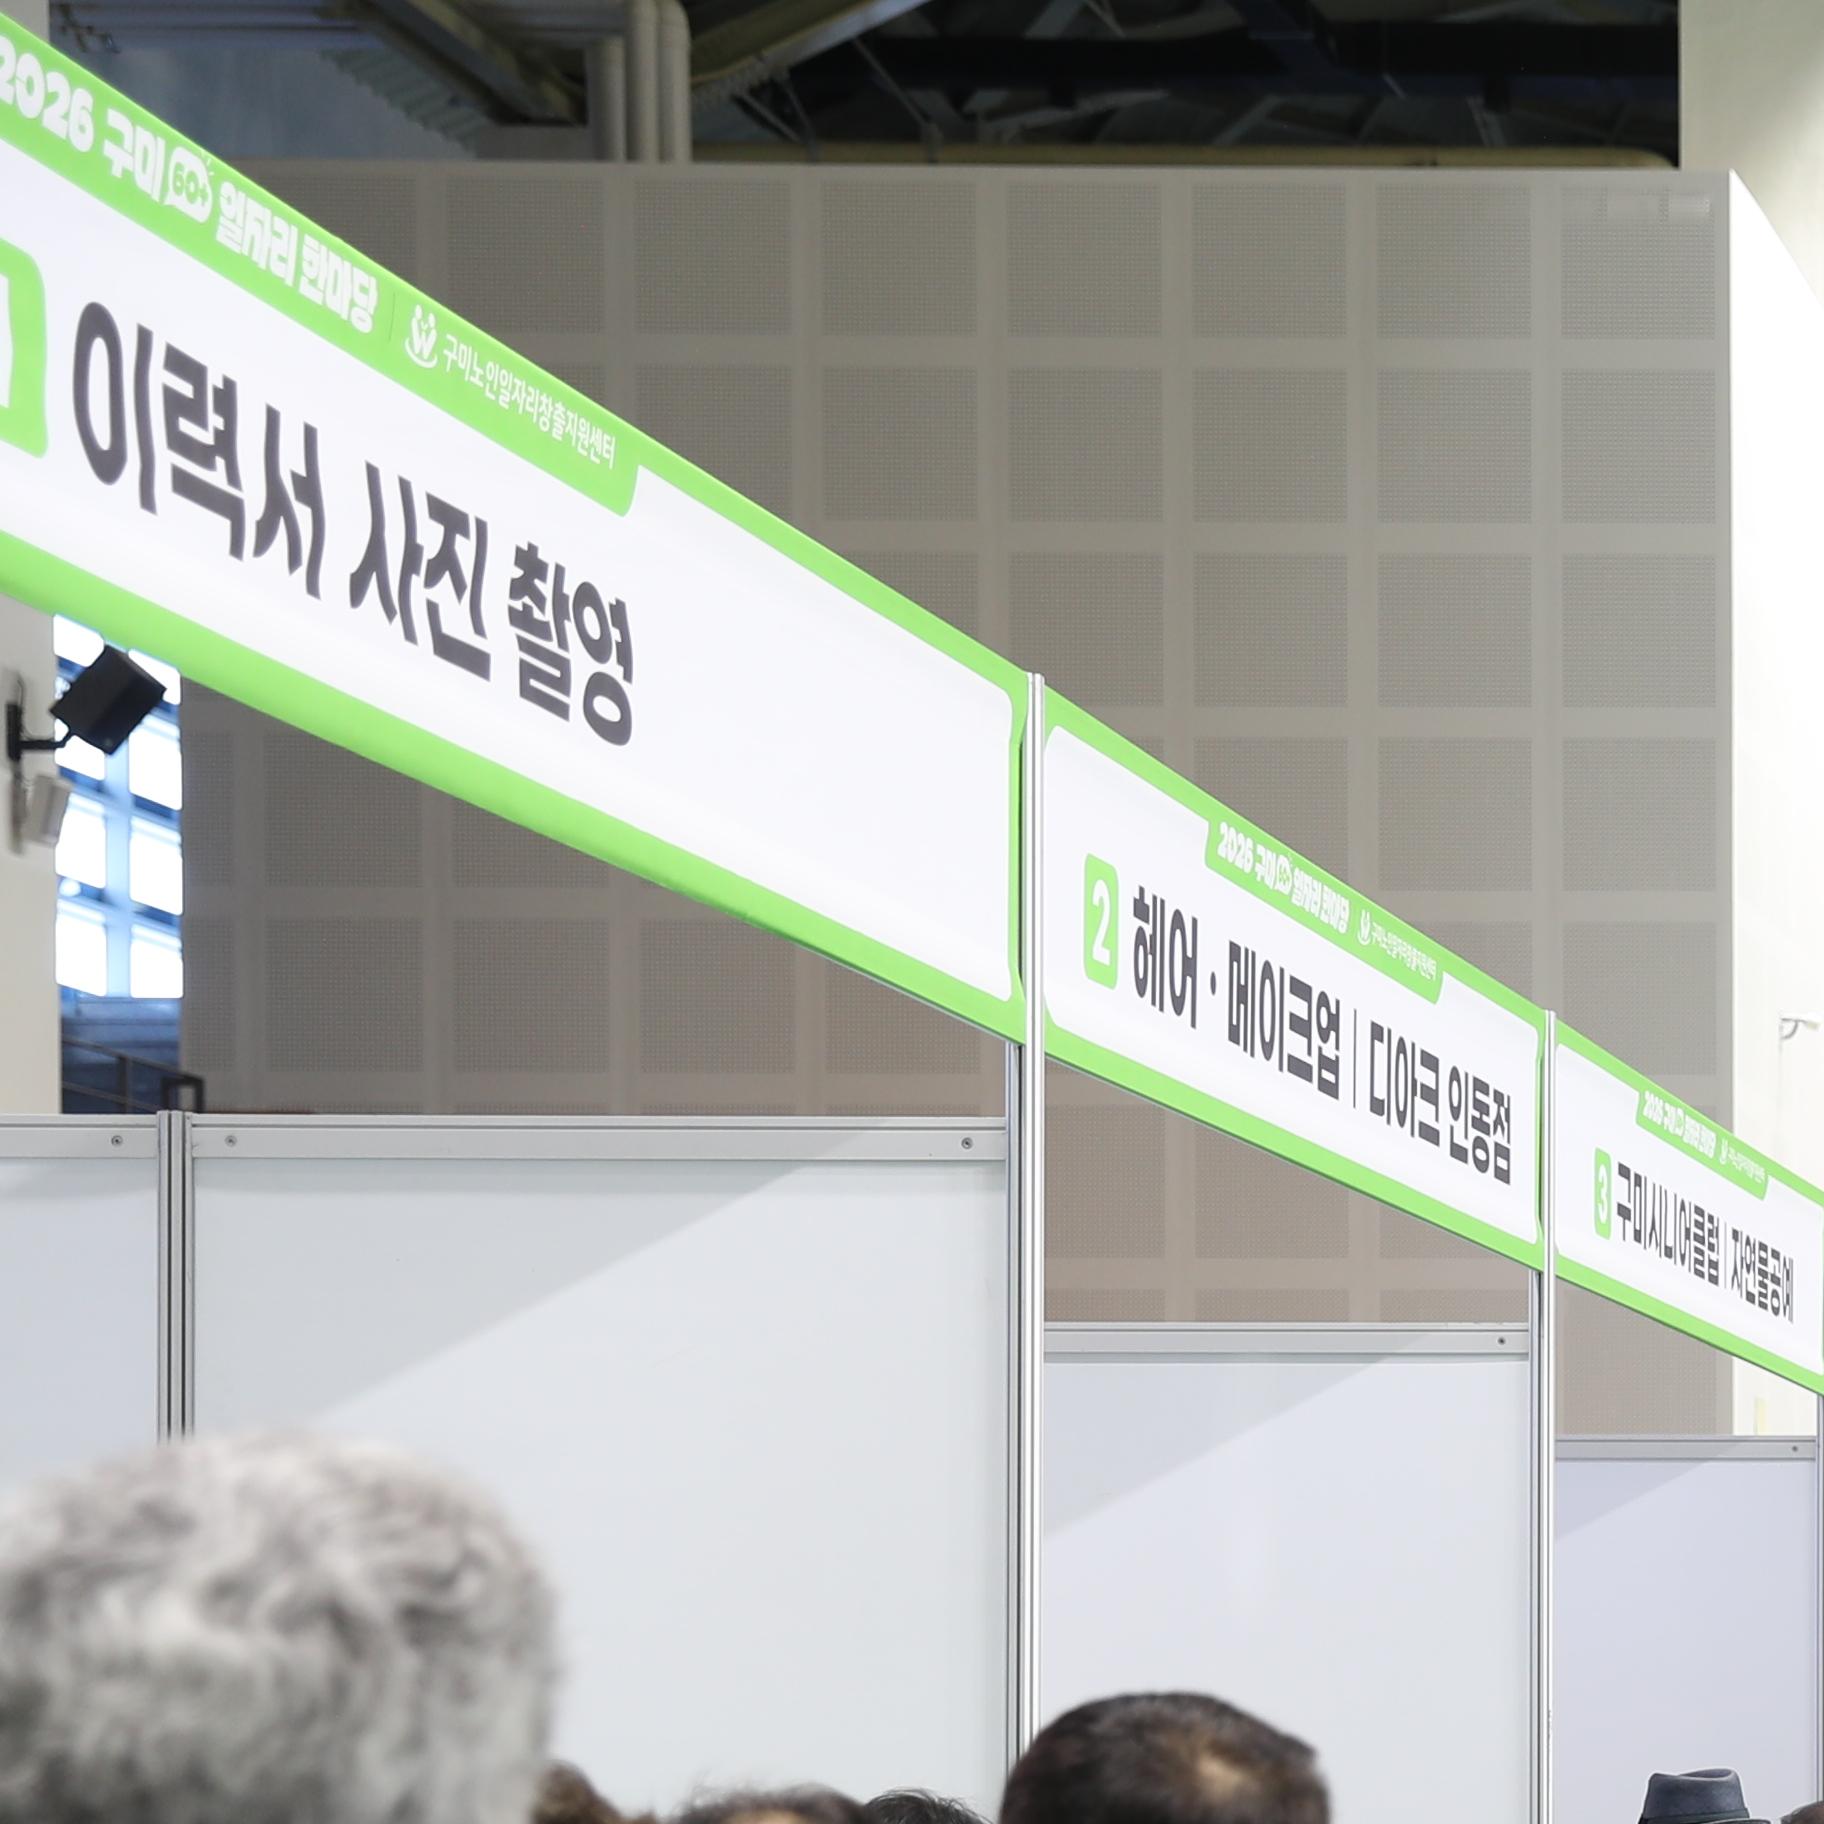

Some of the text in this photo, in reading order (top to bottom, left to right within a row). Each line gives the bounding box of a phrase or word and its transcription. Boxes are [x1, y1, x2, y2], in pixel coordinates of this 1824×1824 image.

[104, 109, 165, 203] 구미
[215, 181, 299, 287] 일자리
[299, 233, 379, 334] 한마당
[442, 333, 616, 470] 구미노인일자리창출지원센터
[71, 300, 634, 746] 이력서 사진 촬영
[1091, 878, 1112, 966] 2
[1217, 821, 1254, 874] 2026
[1132, 885, 1198, 1029] 헤어
[1227, 939, 1341, 1101] 메이크업
[1369, 1020, 1441, 1147] 디아크
[1448, 1063, 1512, 1186] 인동점
[1598, 1164, 1608, 1224] 3
[1617, 1161, 1720, 1287] 구미시니어클럽
[1731, 1227, 1794, 1324] 자연물공예
